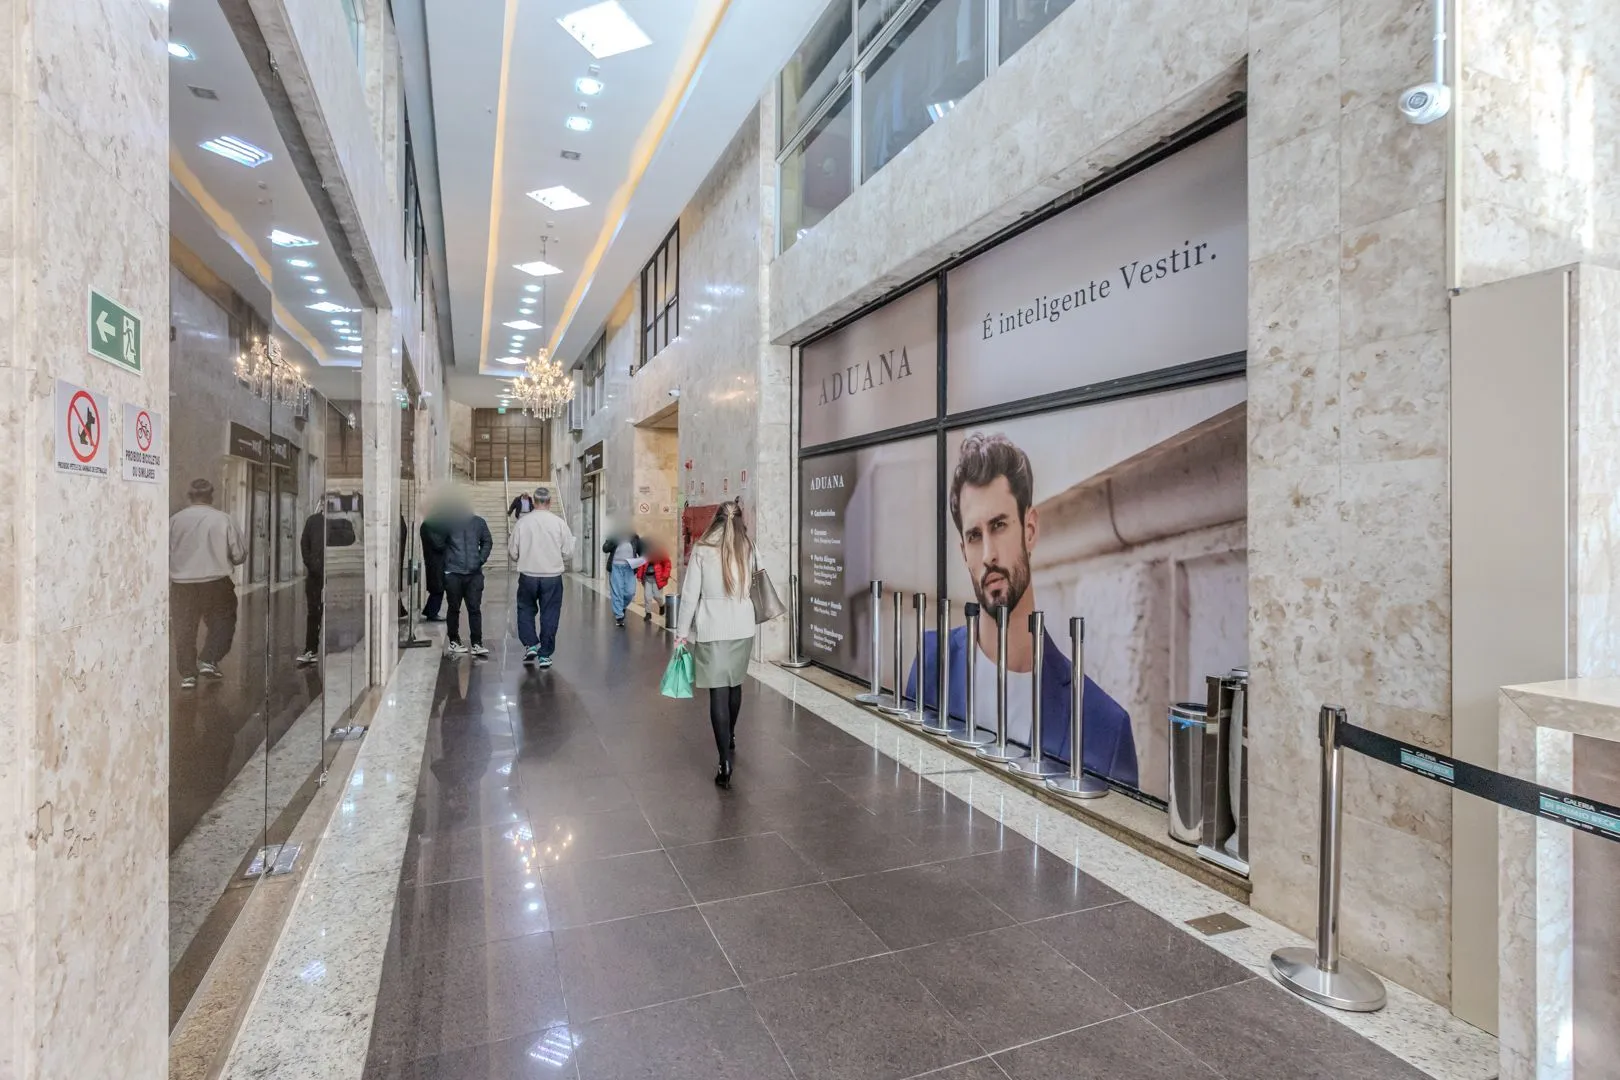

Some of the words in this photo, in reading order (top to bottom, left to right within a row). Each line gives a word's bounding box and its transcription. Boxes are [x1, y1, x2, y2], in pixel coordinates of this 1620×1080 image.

[982, 313, 994, 341] É
[999, 279, 1111, 334] inteligente
[1119, 238, 1217, 290] Vestir.
[818, 345, 913, 406] ADUANA
[810, 475, 845, 491] ADUANA
[1563, 797, 1596, 812] GALERIA
